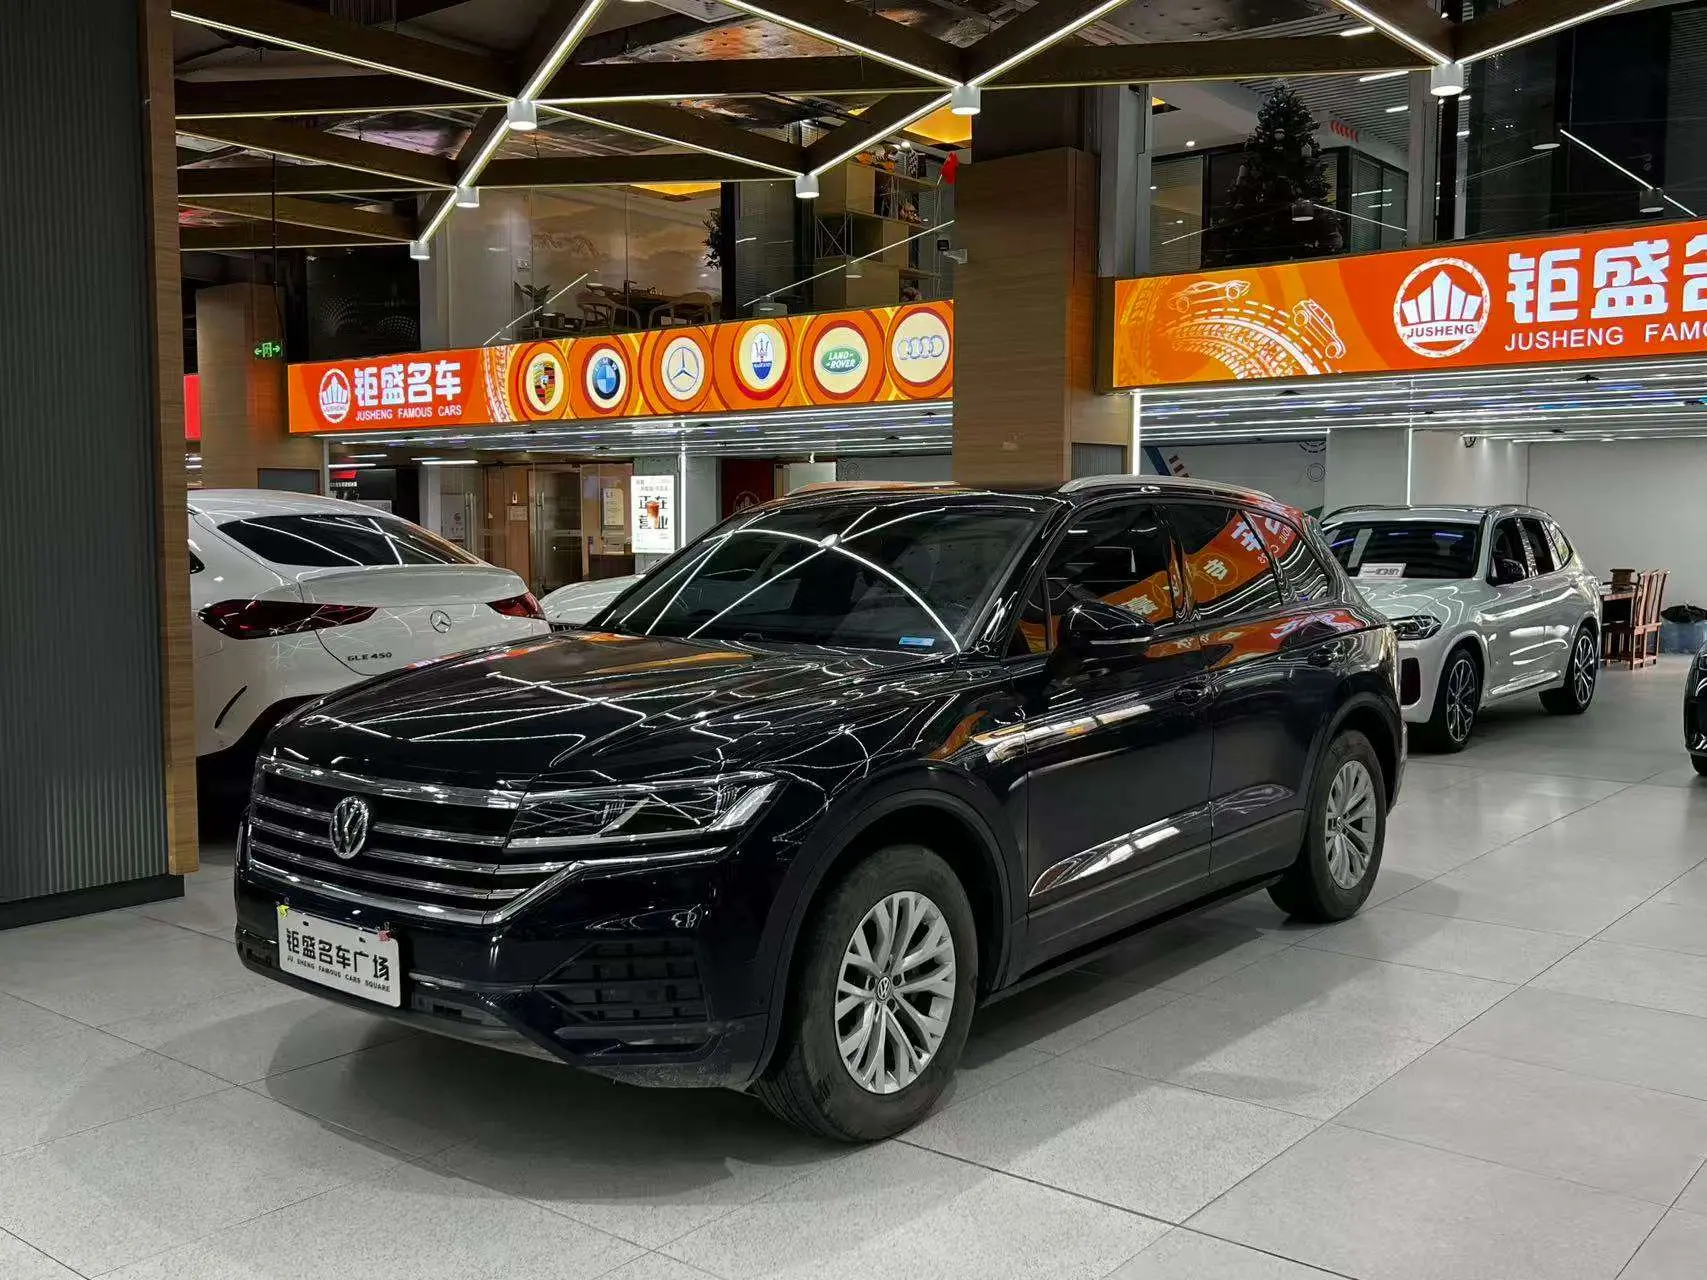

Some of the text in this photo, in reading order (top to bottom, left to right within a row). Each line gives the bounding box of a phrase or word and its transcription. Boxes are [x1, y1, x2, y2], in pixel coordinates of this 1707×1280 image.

[1408, 324, 1474, 338] JUSHENG
[1505, 326, 1624, 351] JUSHENG
[828, 351, 849, 360] LAND
[830, 358, 856, 369] ROVER
[354, 359, 461, 406] 钜盛名车
[355, 404, 462, 421] JUSHENG FAMOUS CARS
[347, 653, 368, 661] GLE
[286, 927, 390, 981] 钜盛名车广场
[365, 980, 391, 992] SQUARE
